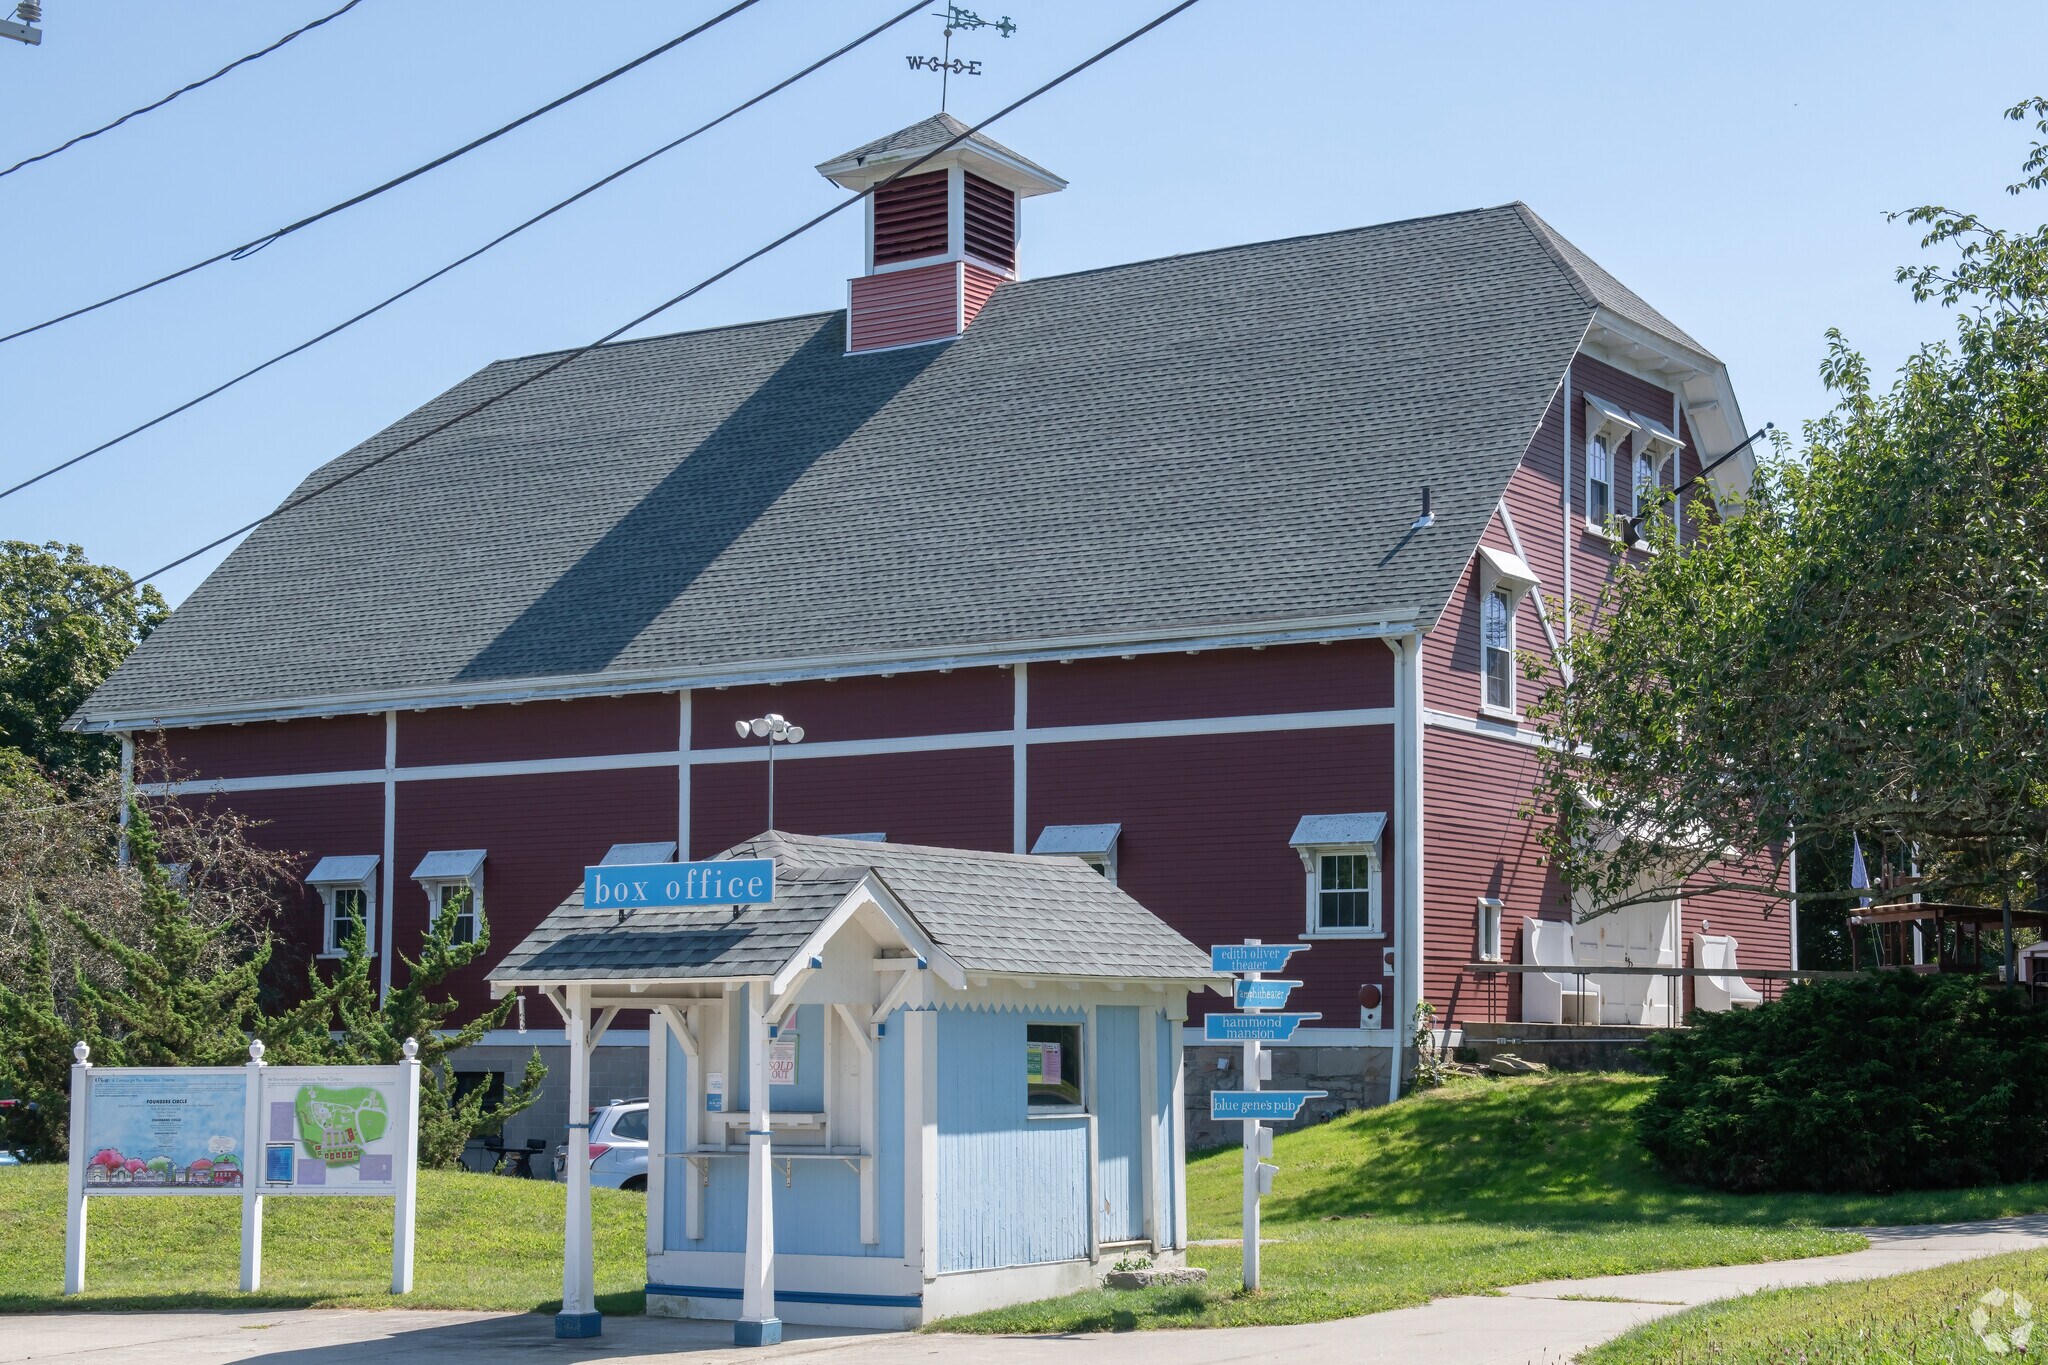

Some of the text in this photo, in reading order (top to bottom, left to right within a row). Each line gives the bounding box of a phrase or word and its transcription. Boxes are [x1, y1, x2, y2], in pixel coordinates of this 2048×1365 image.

[906, 56, 924, 70] W
[968, 61, 982, 76] E
[594, 868, 764, 905] box office
[1221, 946, 1280, 960] edith oliver
[1232, 959, 1268, 971] theater
[1239, 986, 1285, 1002] amphitheater
[1222, 1015, 1282, 1028] hammond
[1226, 1027, 1275, 1039] mansion
[769, 1061, 793, 1071] SOLD
[771, 1070, 790, 1079] OUT
[1214, 1097, 1296, 1114] blue gene's pub
